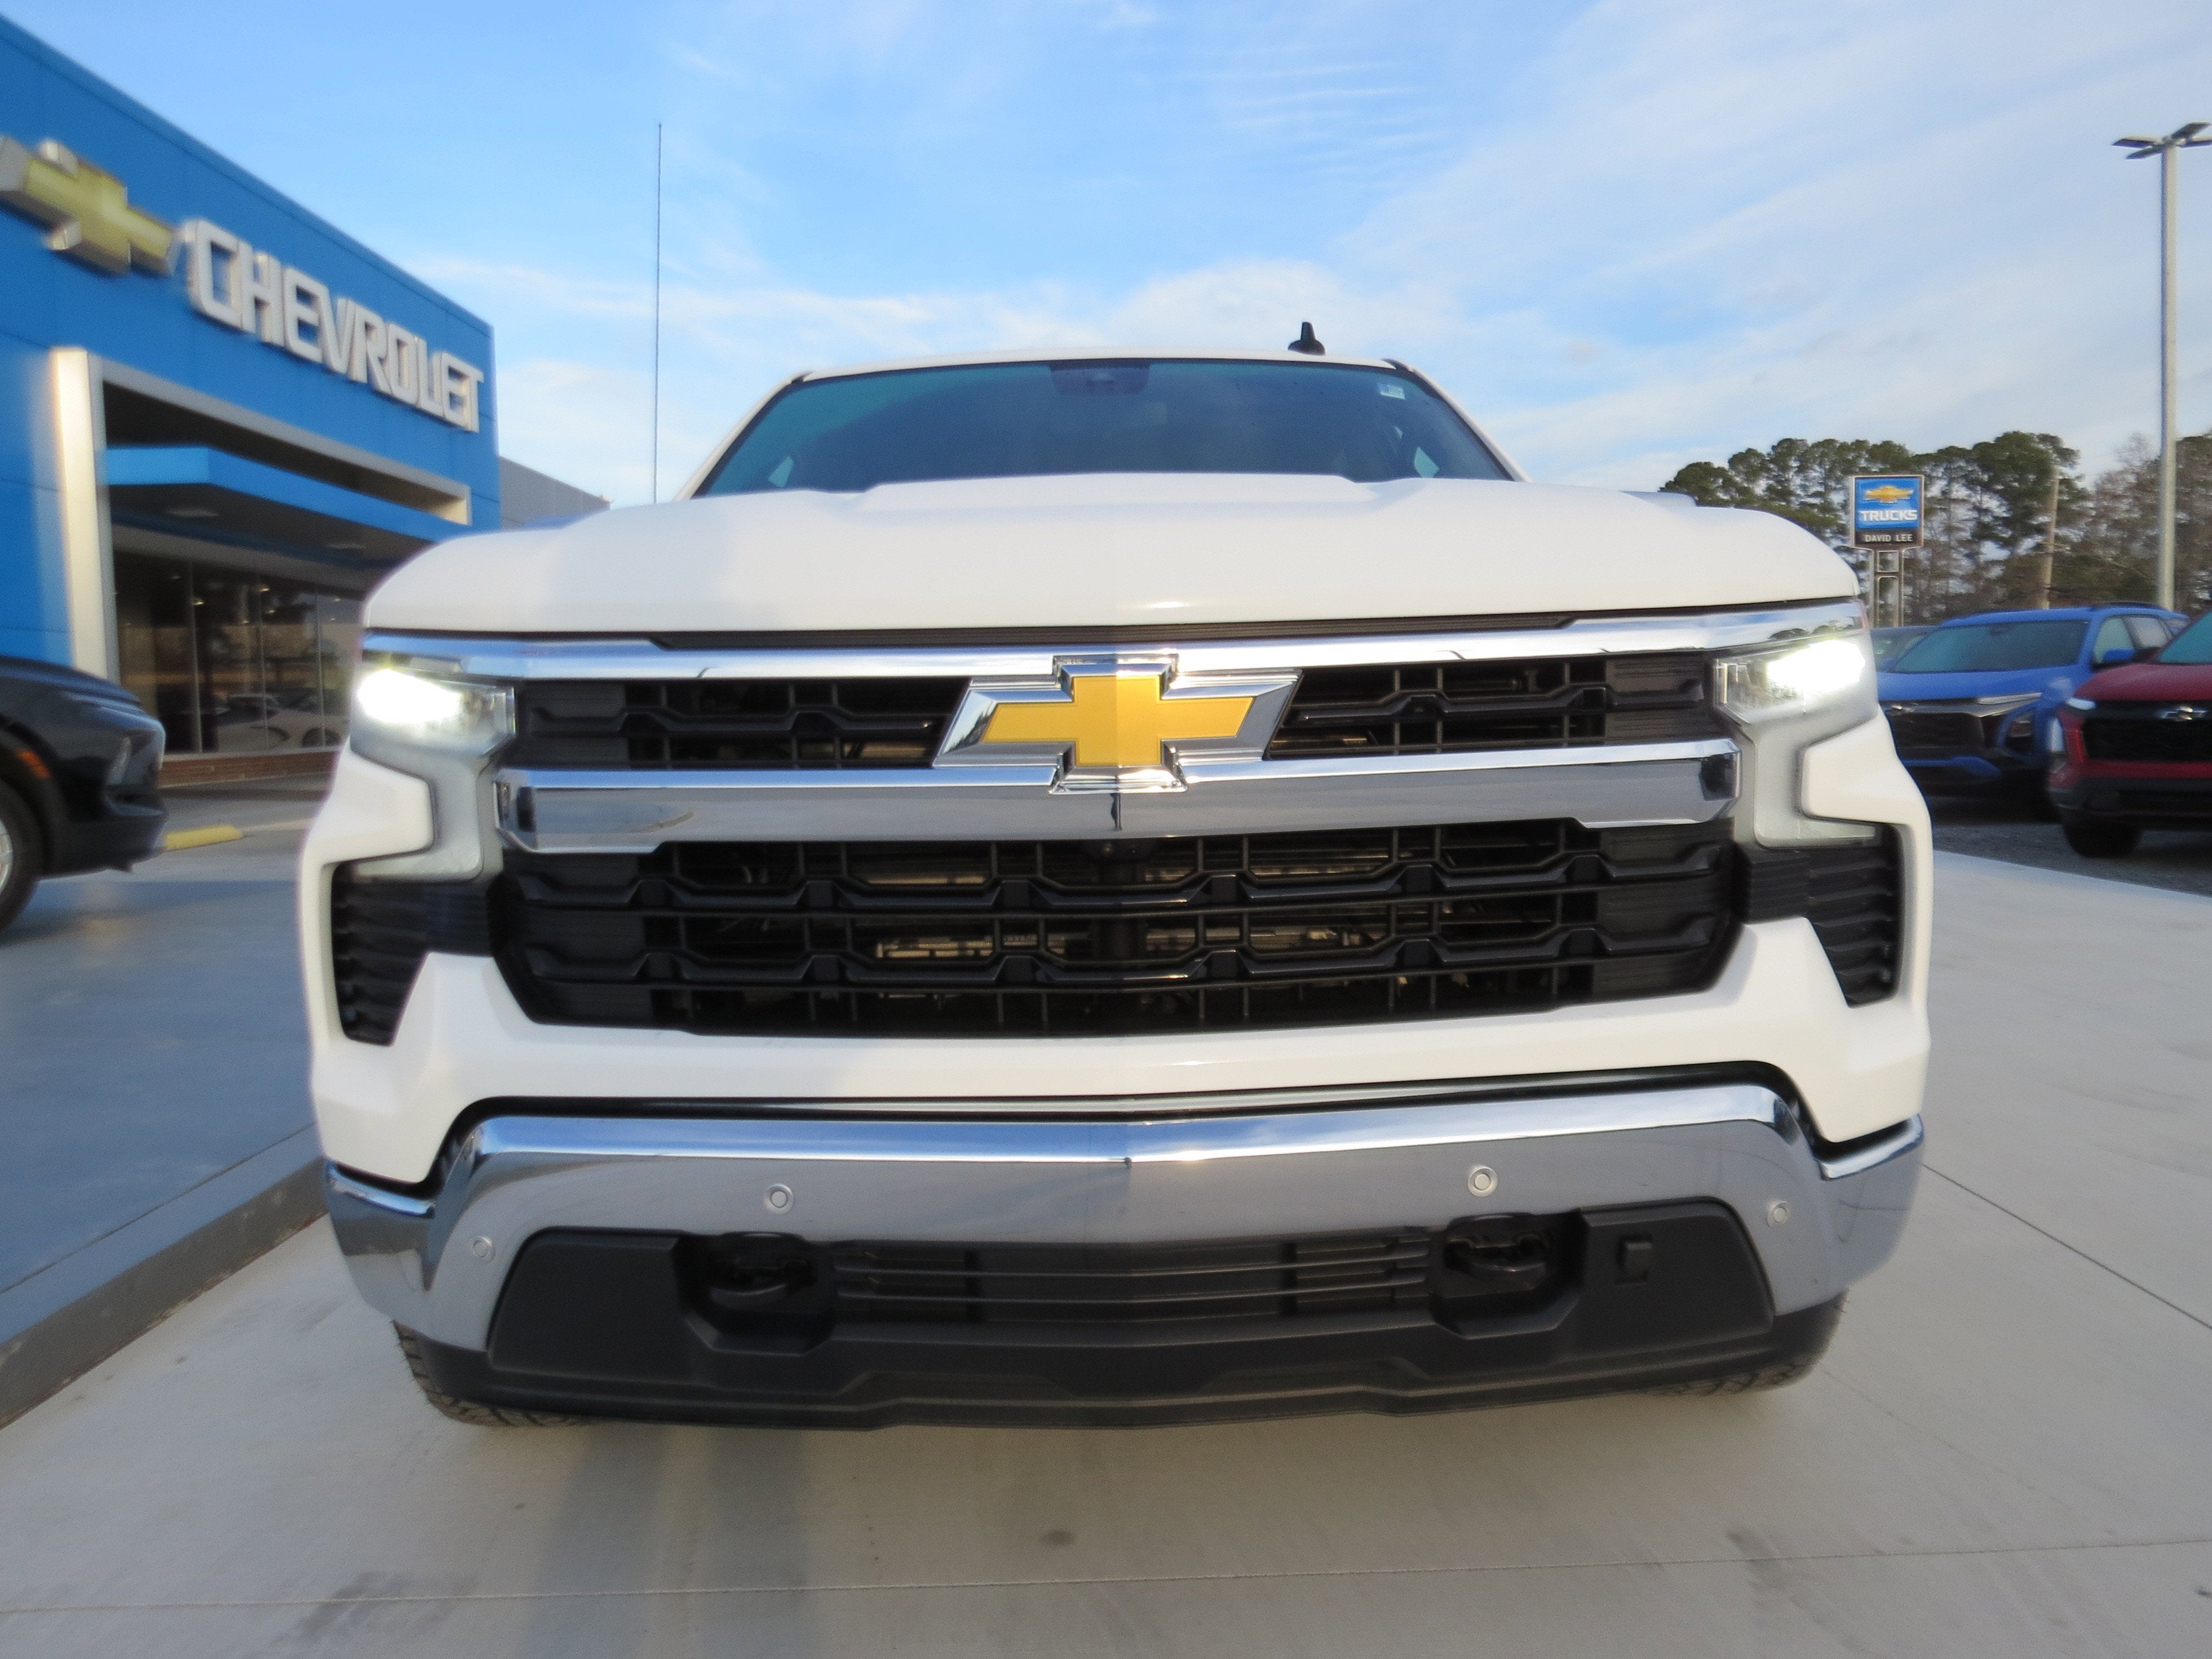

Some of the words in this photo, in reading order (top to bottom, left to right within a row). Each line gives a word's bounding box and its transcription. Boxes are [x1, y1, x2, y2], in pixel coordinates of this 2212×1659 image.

[182, 218, 484, 434] CHEVROLET
[1860, 509, 1917, 521] TRUCKS
[1865, 534, 1891, 542] DAVID
[1896, 534, 1913, 542] LEE
